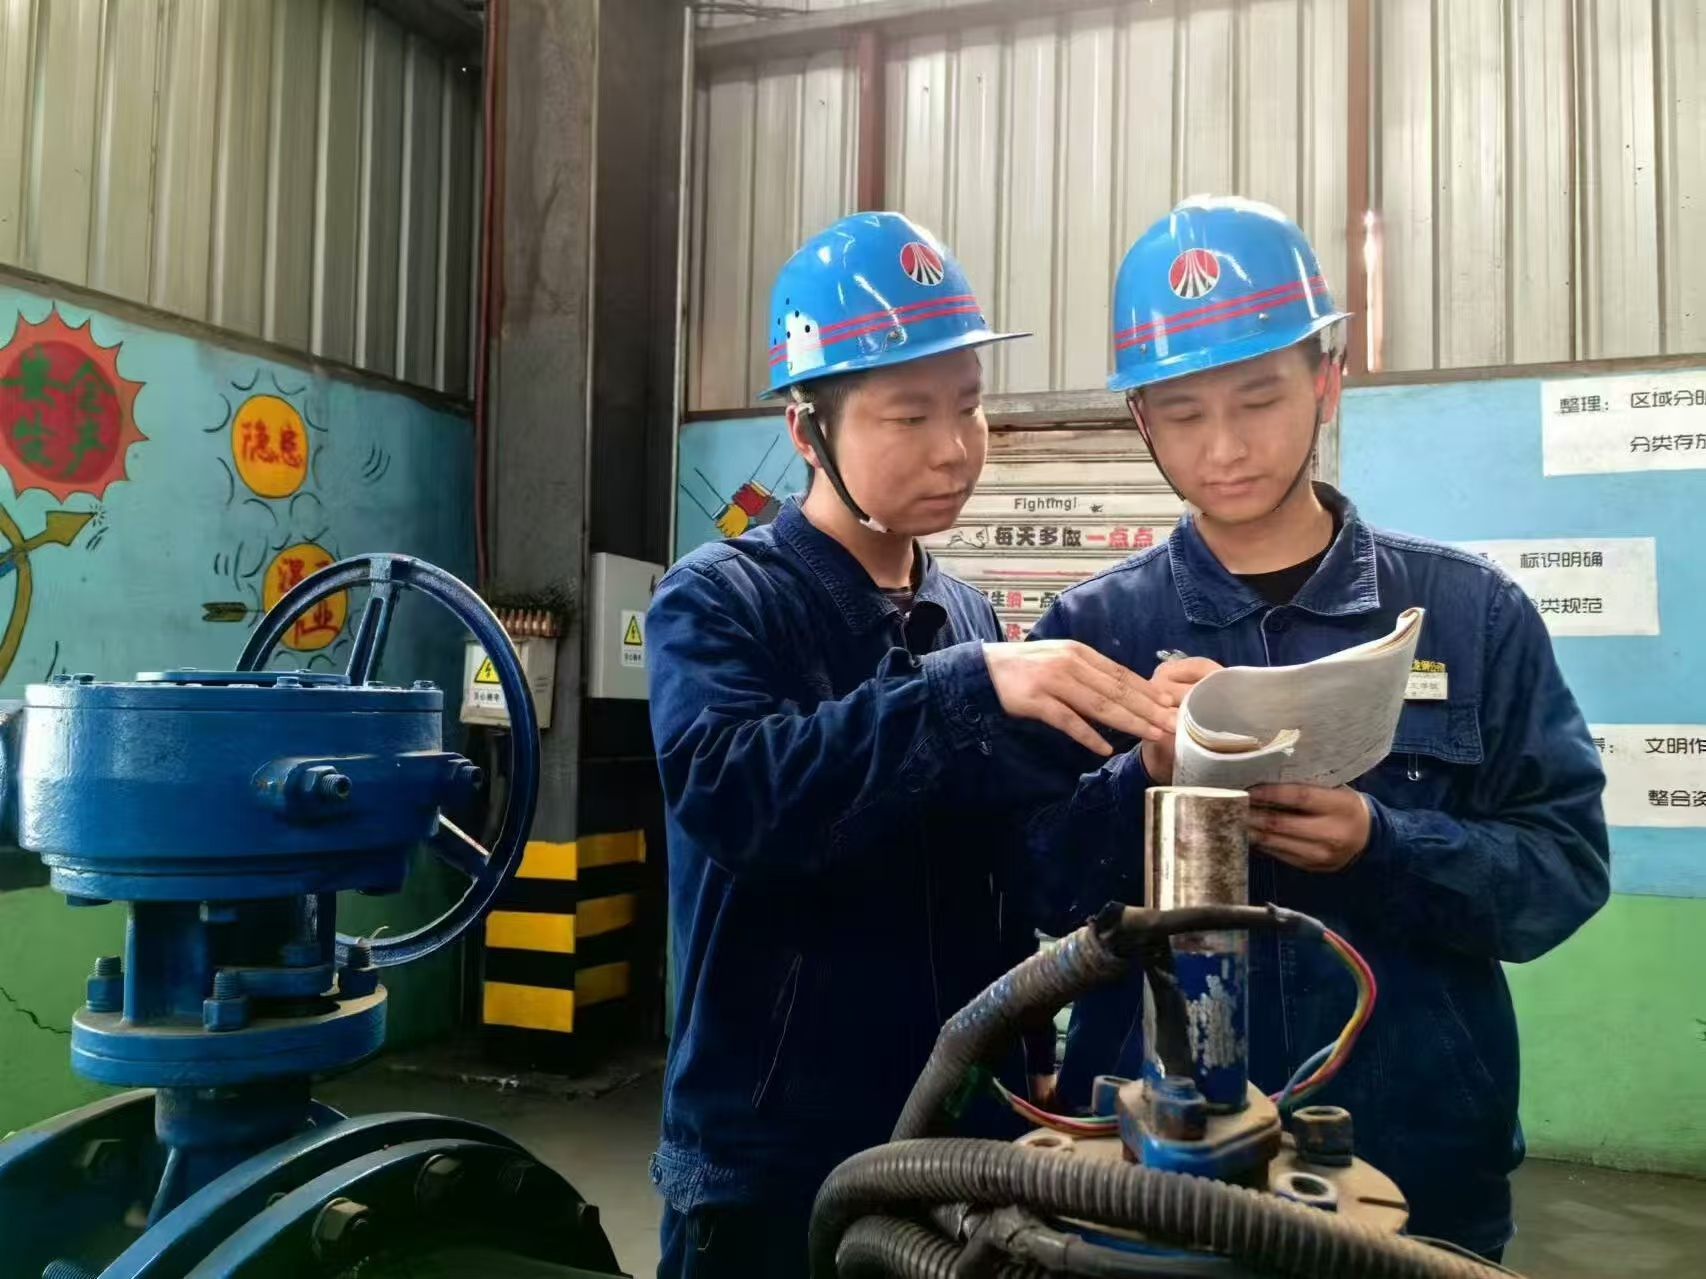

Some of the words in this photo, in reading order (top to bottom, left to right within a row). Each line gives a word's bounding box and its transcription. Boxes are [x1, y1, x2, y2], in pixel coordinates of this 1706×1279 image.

[1559, 395, 1610, 414] 整理：
[994, 526, 1153, 548] 每天多做一点点
[1520, 551, 1603, 568] 标识明确
[1531, 598, 1602, 613] 类规范
[1644, 736, 1706, 755] 文明作
[1648, 789, 1706, 807] 整合资
